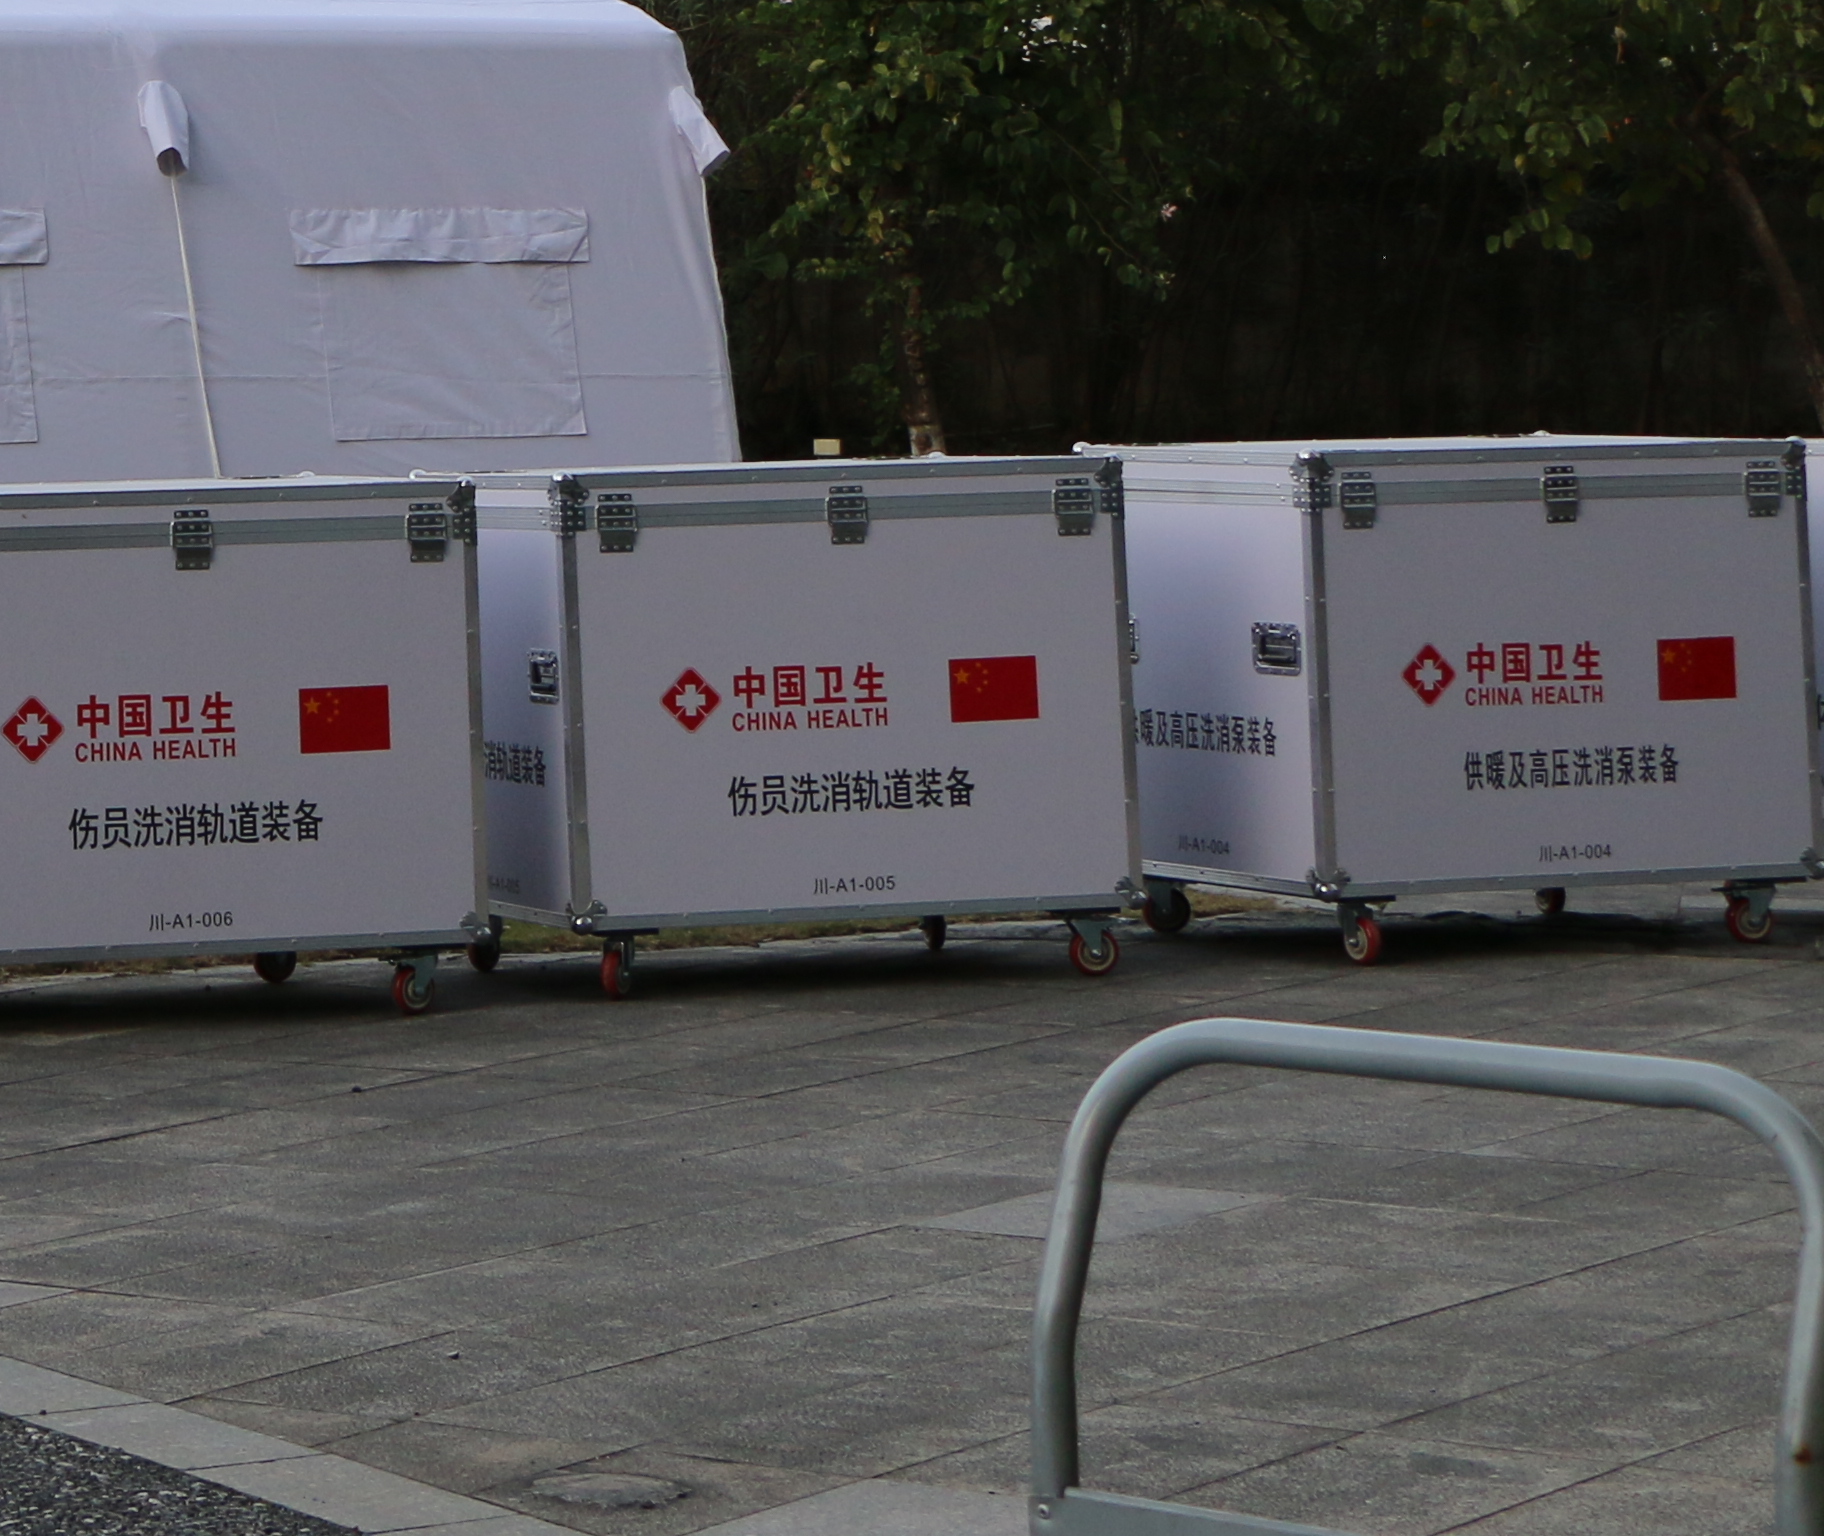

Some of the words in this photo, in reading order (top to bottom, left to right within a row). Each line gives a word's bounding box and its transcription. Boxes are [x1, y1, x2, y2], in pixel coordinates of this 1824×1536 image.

[1467, 643, 1603, 683] 中国卫生
[734, 664, 887, 708] 中国卫生
[1468, 689, 1523, 706] CHINA
[1533, 684, 1605, 705] HEALTH
[78, 693, 236, 738] 中国卫生
[732, 712, 798, 732] CHINA
[808, 708, 889, 728] HEALTH
[77, 743, 143, 762] CHINA
[151, 738, 237, 760] HEALTH
[1464, 744, 1678, 790] 供暖及高压洗消泵装备
[728, 767, 974, 816] 伤员洗消轨道装备
[69, 799, 323, 849] 伤员洗消轨道装备
